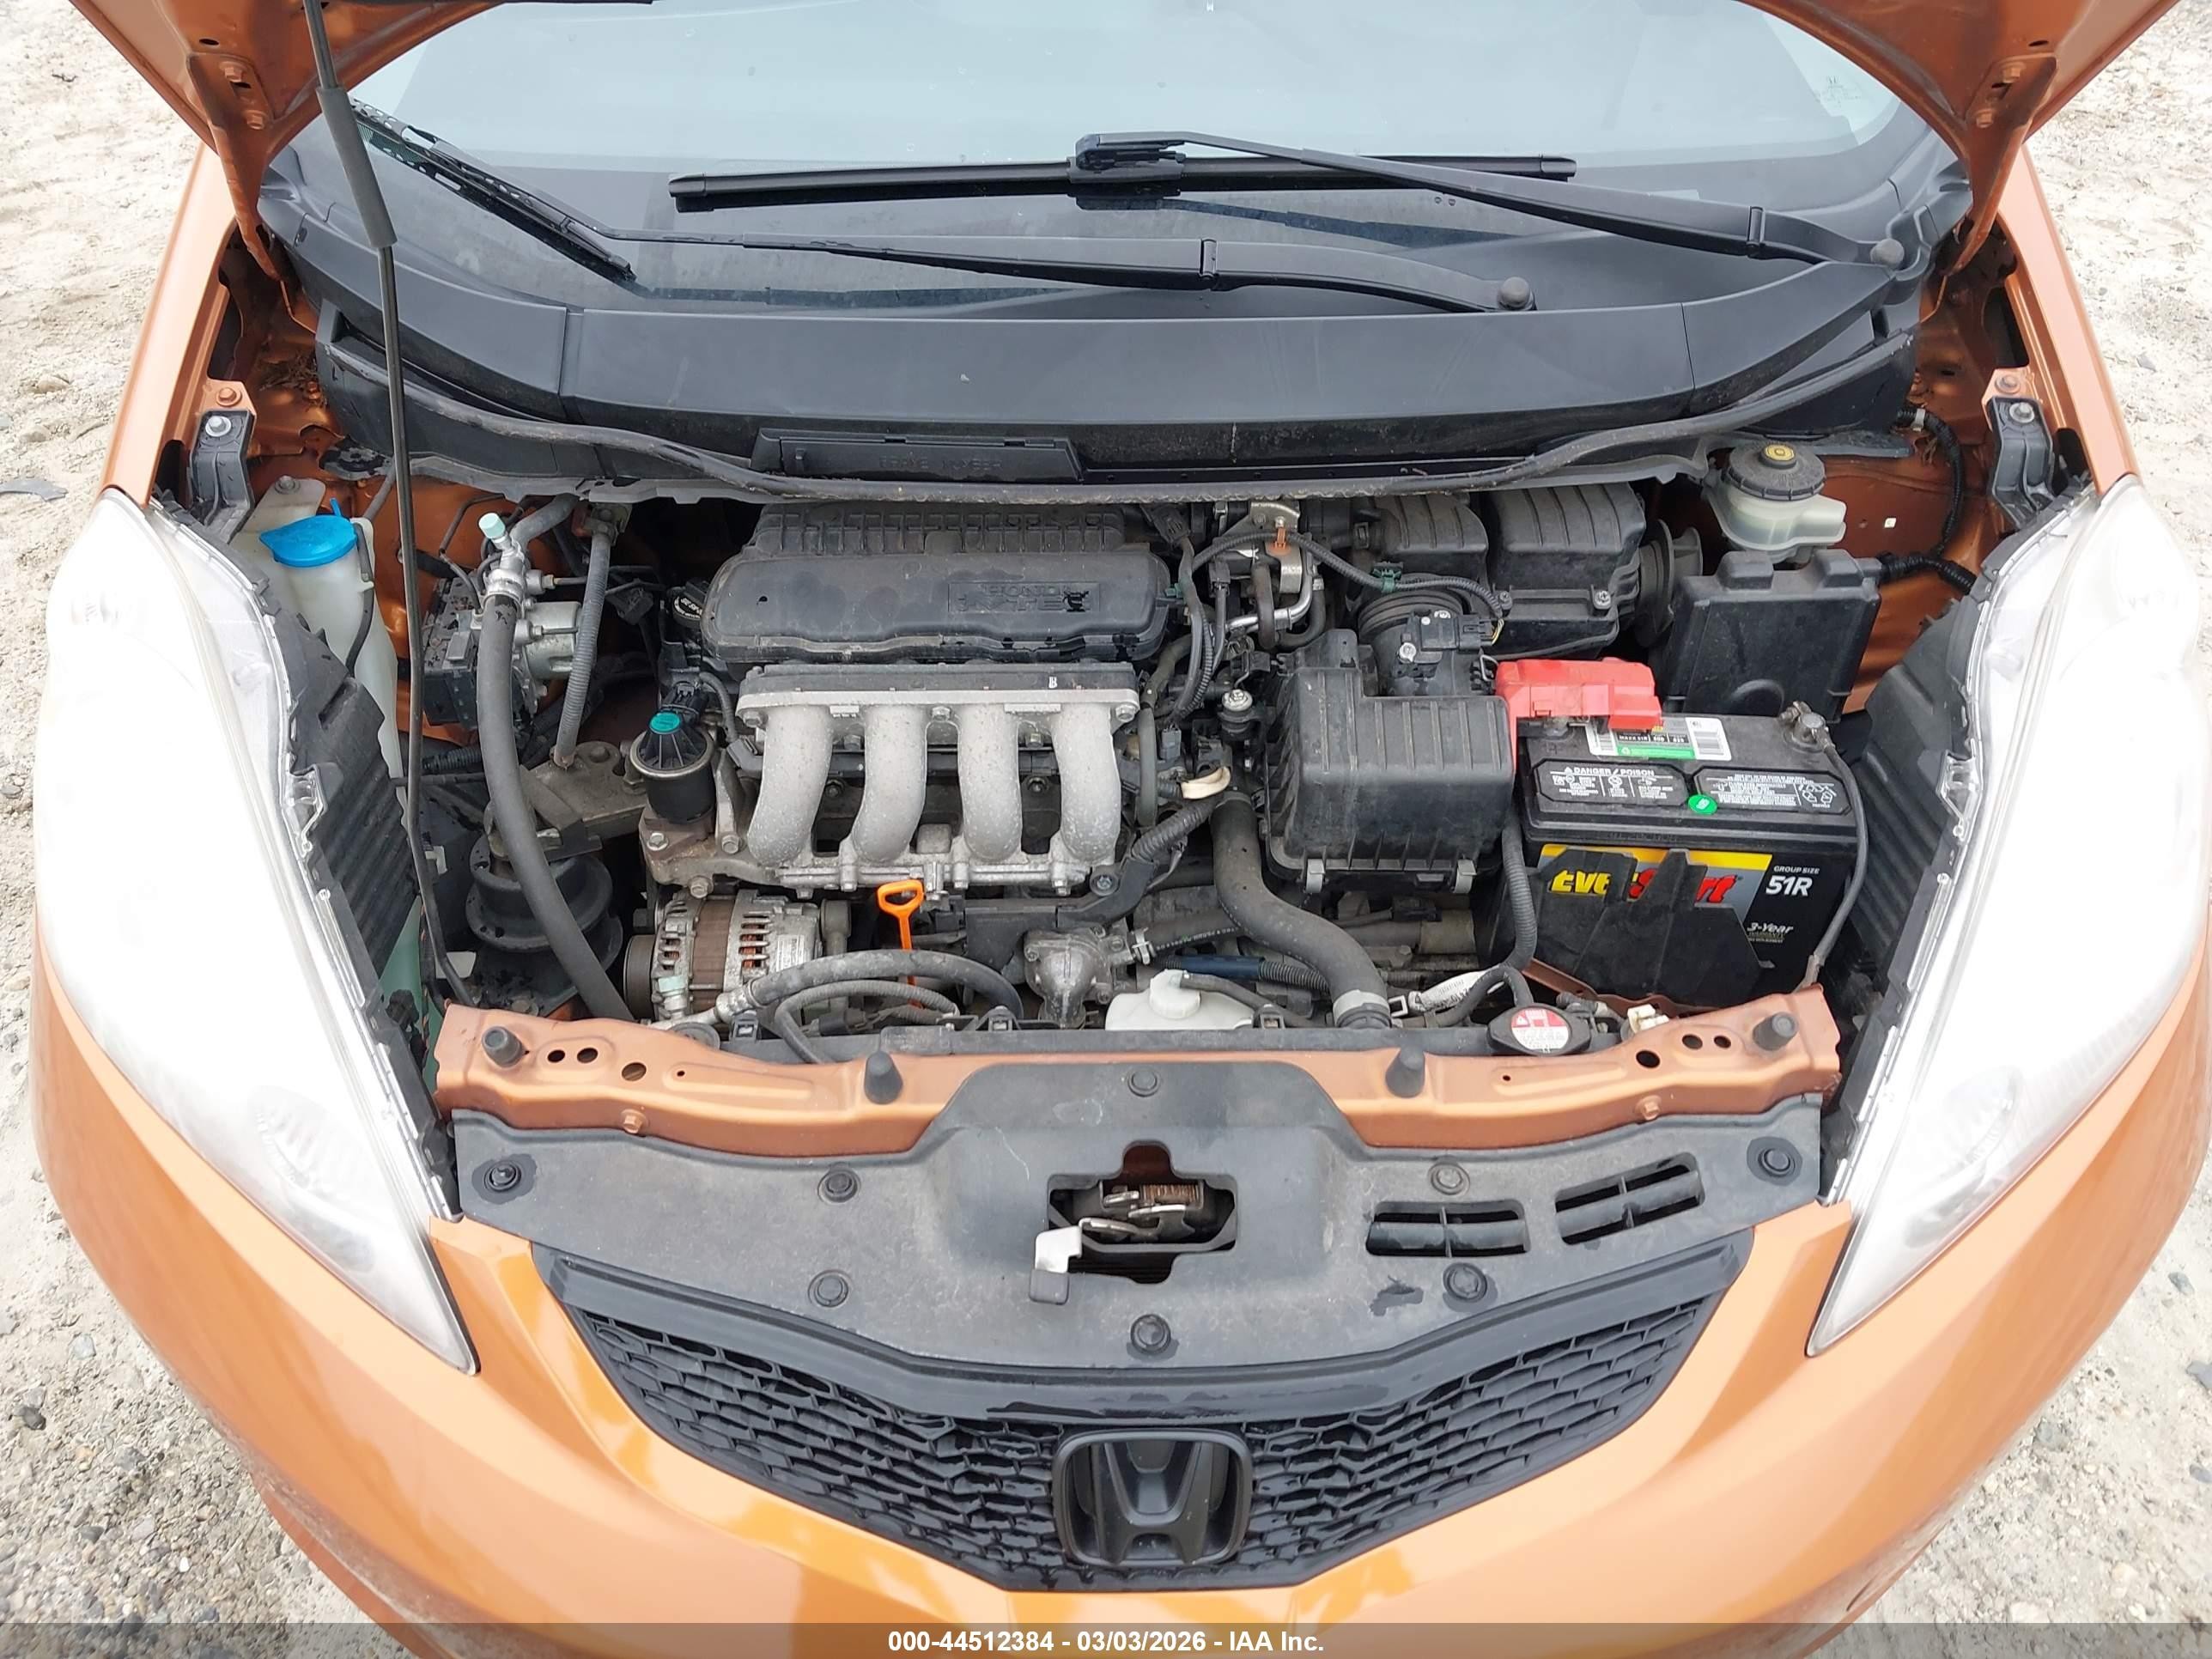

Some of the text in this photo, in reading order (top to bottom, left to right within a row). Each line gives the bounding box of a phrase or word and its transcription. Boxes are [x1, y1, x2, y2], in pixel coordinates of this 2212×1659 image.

[1573, 767, 1611, 775] DANGER
[1620, 769, 1655, 777] POISON
[1773, 865, 1820, 875] GROUP SIZE
[1765, 875, 1814, 896] 51R
[1747, 922, 1794, 934] 3-Year
